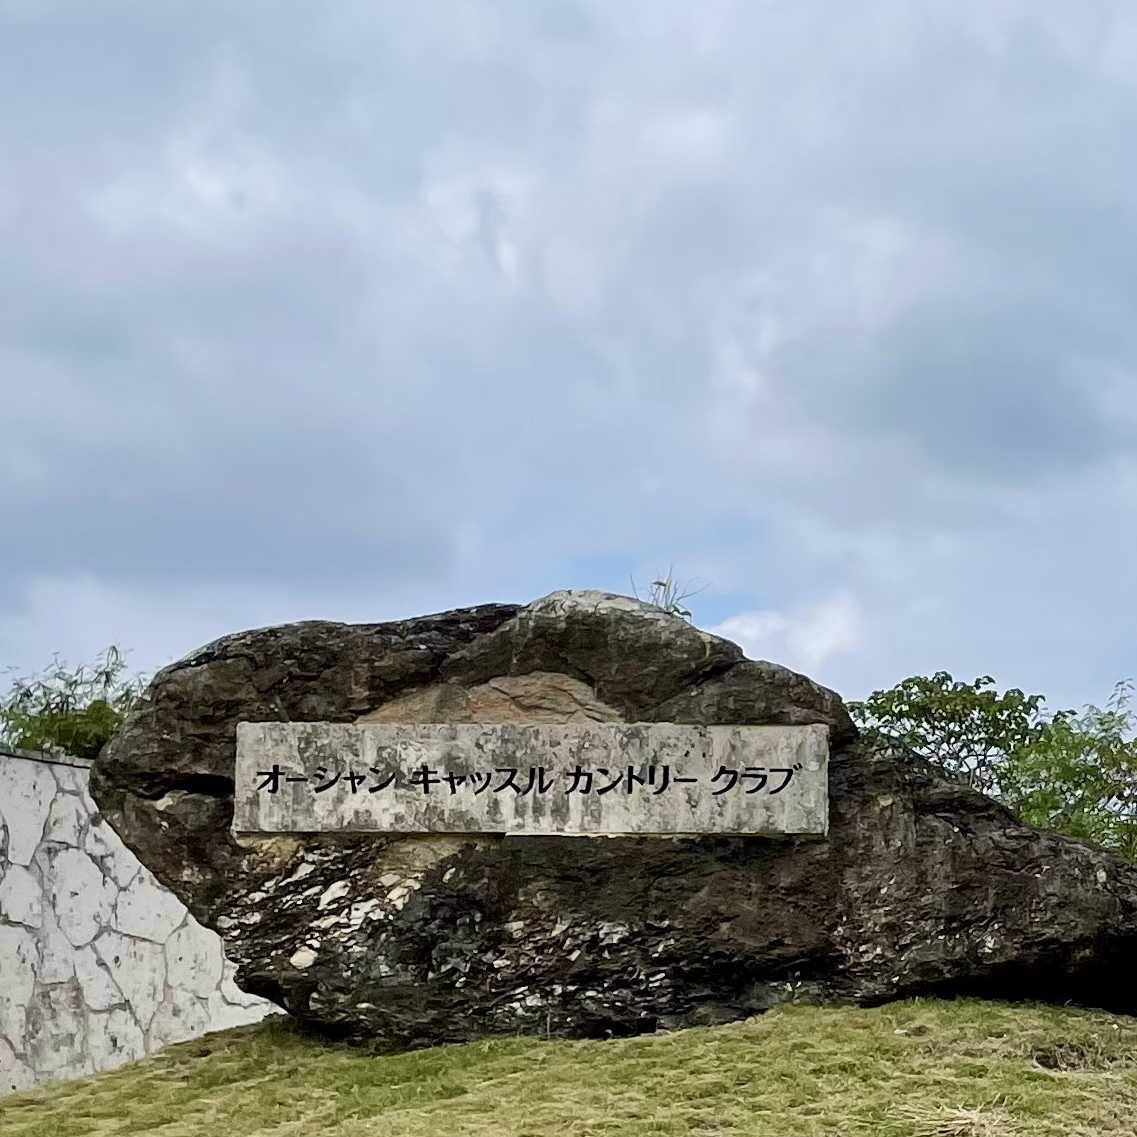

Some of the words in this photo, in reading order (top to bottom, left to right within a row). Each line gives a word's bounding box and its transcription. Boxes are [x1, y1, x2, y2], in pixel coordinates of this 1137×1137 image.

[256, 764, 396, 794] オーシャン
[409, 765, 554, 795] キャッスル
[565, 765, 698, 795] カントリー
[711, 763, 803, 796] クラブ
